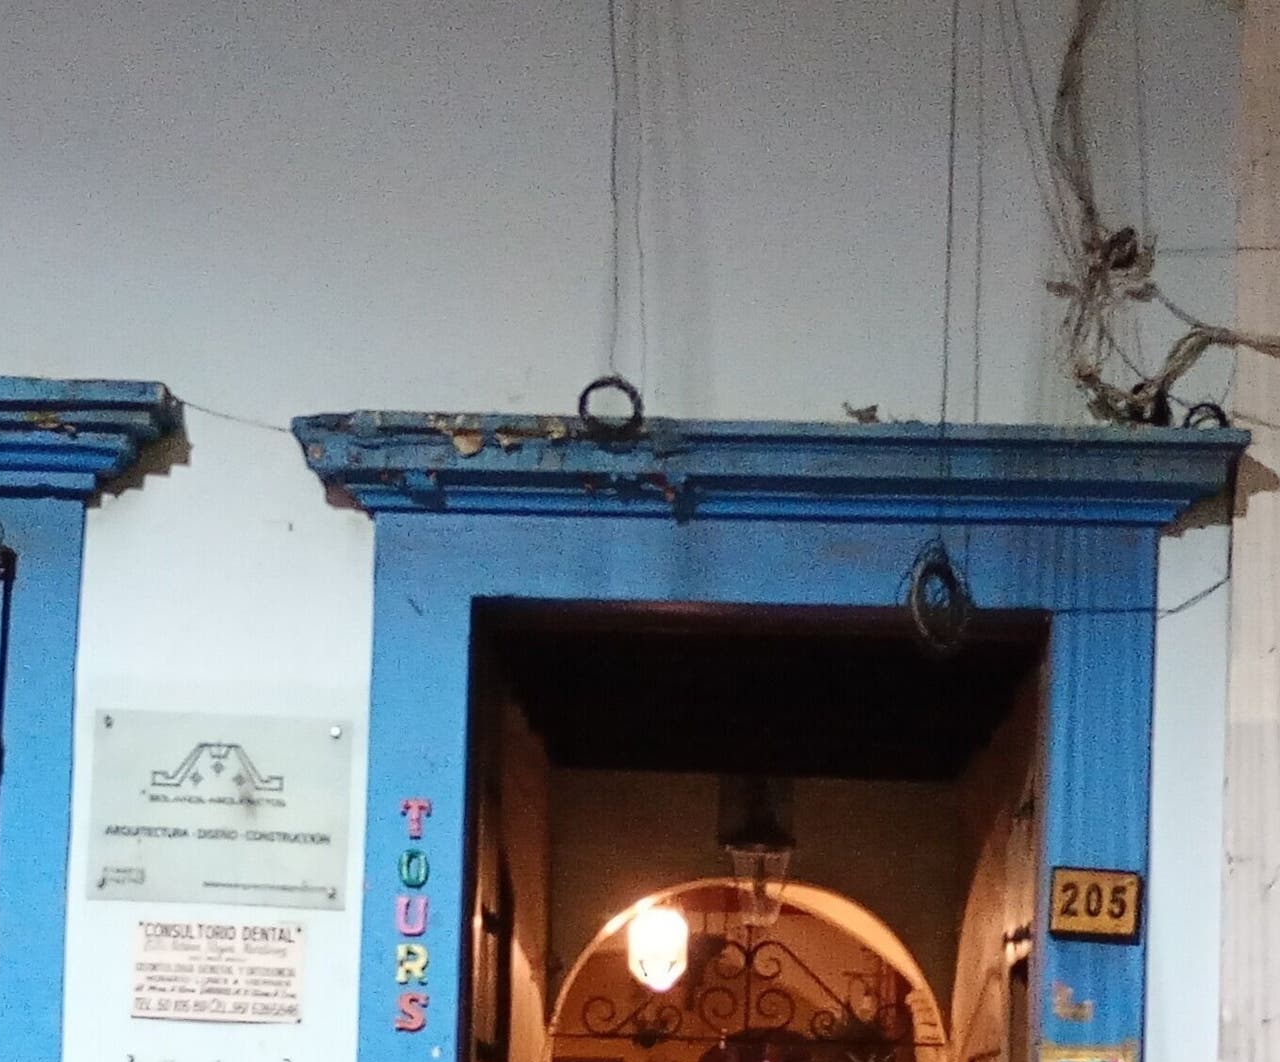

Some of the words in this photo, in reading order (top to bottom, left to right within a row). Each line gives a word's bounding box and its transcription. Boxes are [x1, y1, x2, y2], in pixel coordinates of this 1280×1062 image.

[104, 823, 189, 838] ARQUITECTURA
[394, 797, 433, 1033] TOURS
[1059, 881, 1128, 920] 205
[144, 922, 236, 941] CONSULTORIO
[241, 925, 296, 944] DENTAL
